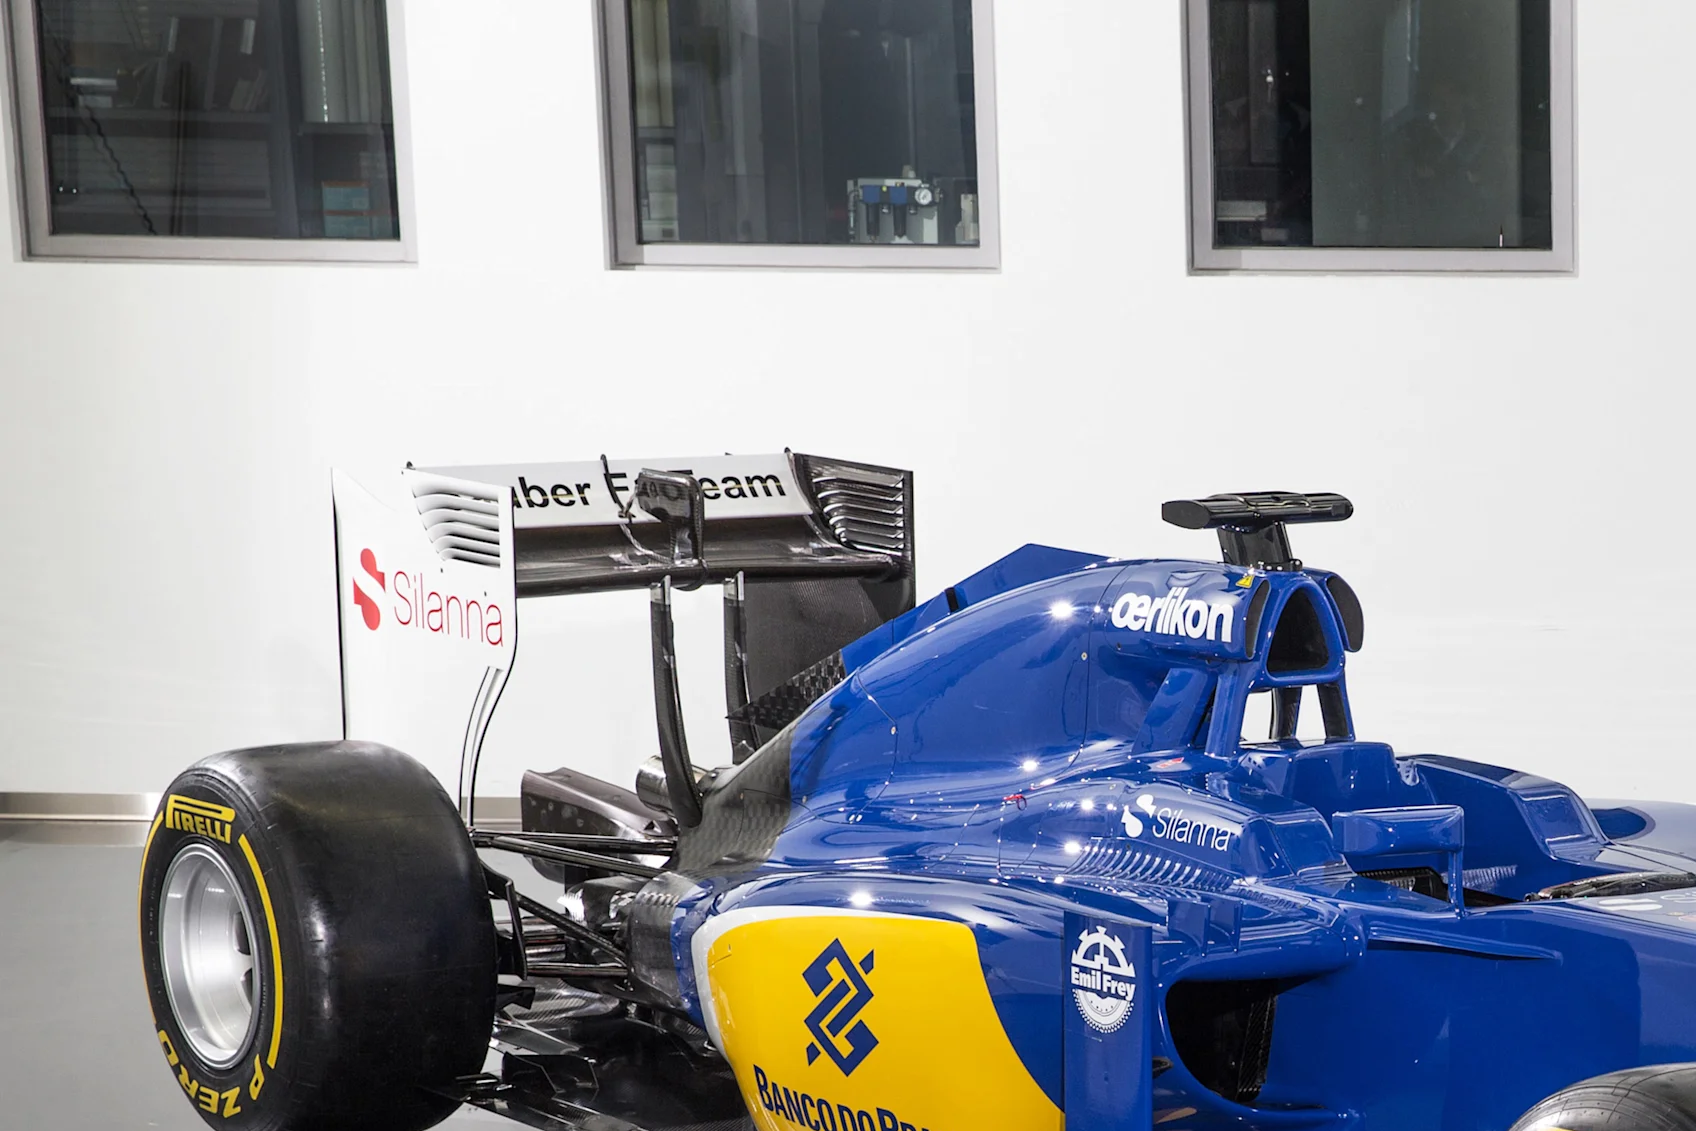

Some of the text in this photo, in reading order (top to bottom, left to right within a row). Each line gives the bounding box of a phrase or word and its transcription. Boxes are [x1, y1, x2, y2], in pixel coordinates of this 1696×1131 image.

[394, 571, 503, 647] Silanna
[165, 794, 236, 844] PIRELLI
[1152, 807, 1231, 851] Silanna
[1071, 965, 1136, 1002] Emil Frey
[158, 1029, 265, 1118] P ZERO
